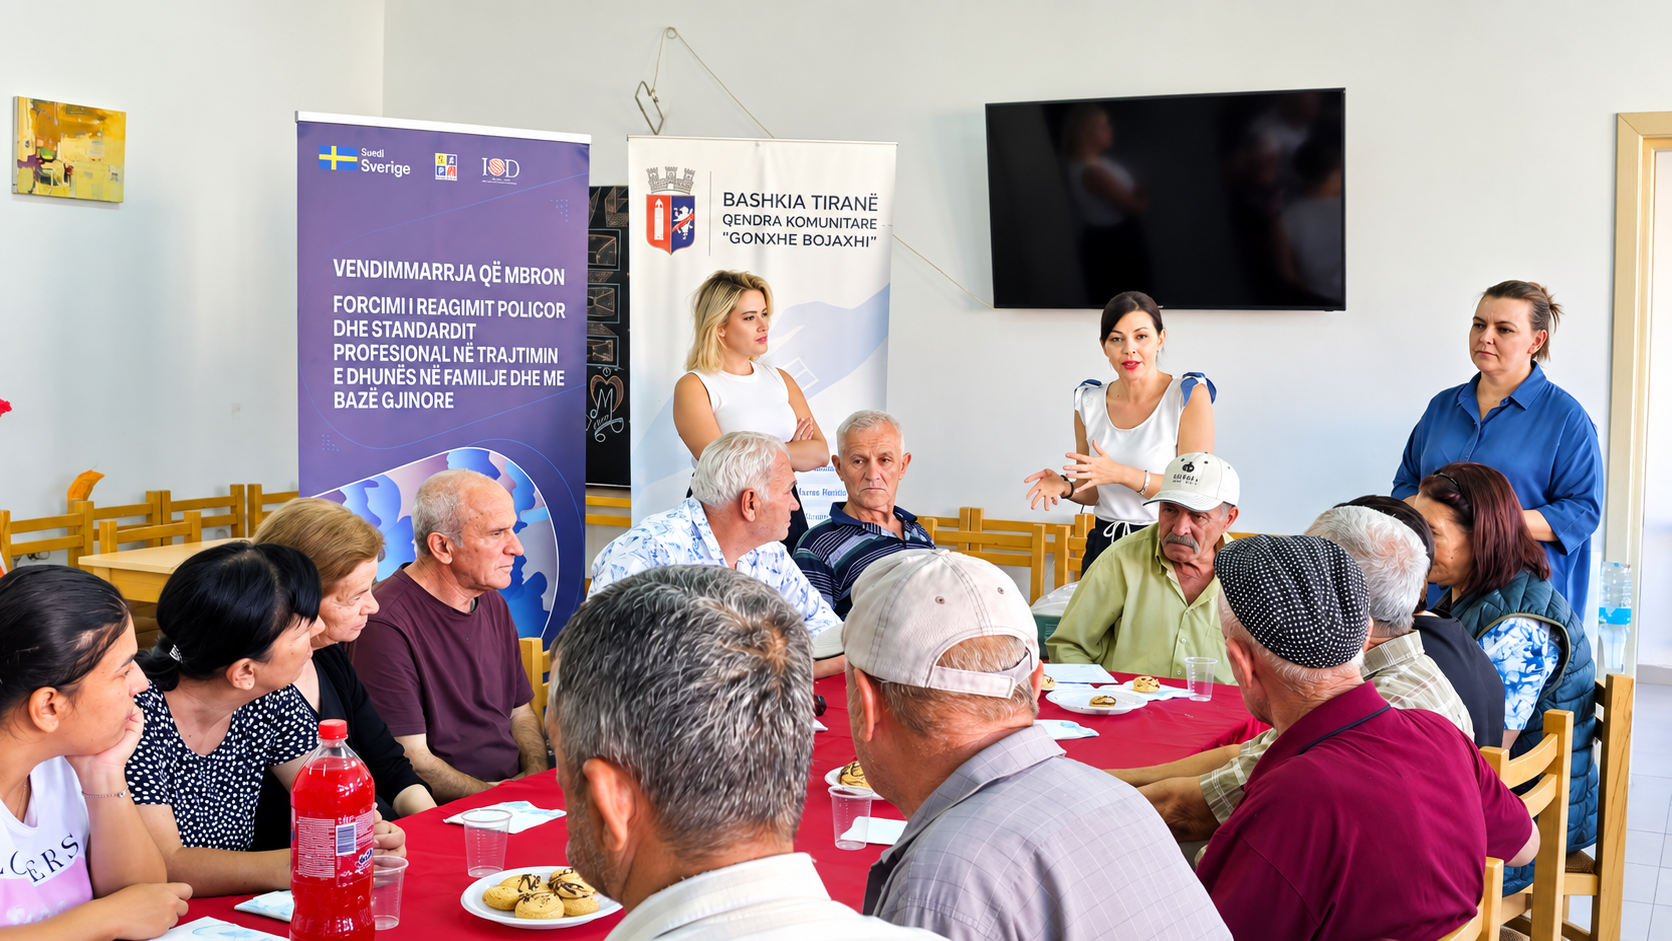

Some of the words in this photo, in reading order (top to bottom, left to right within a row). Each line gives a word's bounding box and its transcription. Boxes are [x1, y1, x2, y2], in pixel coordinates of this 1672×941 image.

[361, 159, 411, 177] Sverige
[723, 192, 806, 209] BASHKIA
[811, 193, 878, 212] TIRANË
[722, 213, 782, 228] QENDRA
[786, 216, 877, 230] KOMUNITARE
[333, 259, 477, 283] VENDIMMARRJA
[479, 261, 502, 288] QË
[505, 267, 565, 286] MBRON
[333, 296, 406, 315] FORCIMI
[409, 297, 414, 315] I
[416, 298, 495, 317] REAGIMIT
[497, 300, 566, 319] POLICOR
[333, 320, 369, 337] DHE
[371, 321, 477, 340] STANDARDIT
[333, 343, 451, 363] PROFESIONAL
[453, 342, 474, 363] NË
[476, 346, 559, 364] TRAJTIMIN
[333, 367, 344, 385] E
[346, 365, 417, 386] DHUNËS
[419, 365, 441, 386] NË
[444, 368, 507, 386] FAMILJE
[510, 370, 541, 387] DHE
[543, 370, 565, 387] ME
[333, 387, 379, 409] BAZË
[381, 391, 454, 409] GJINORE
